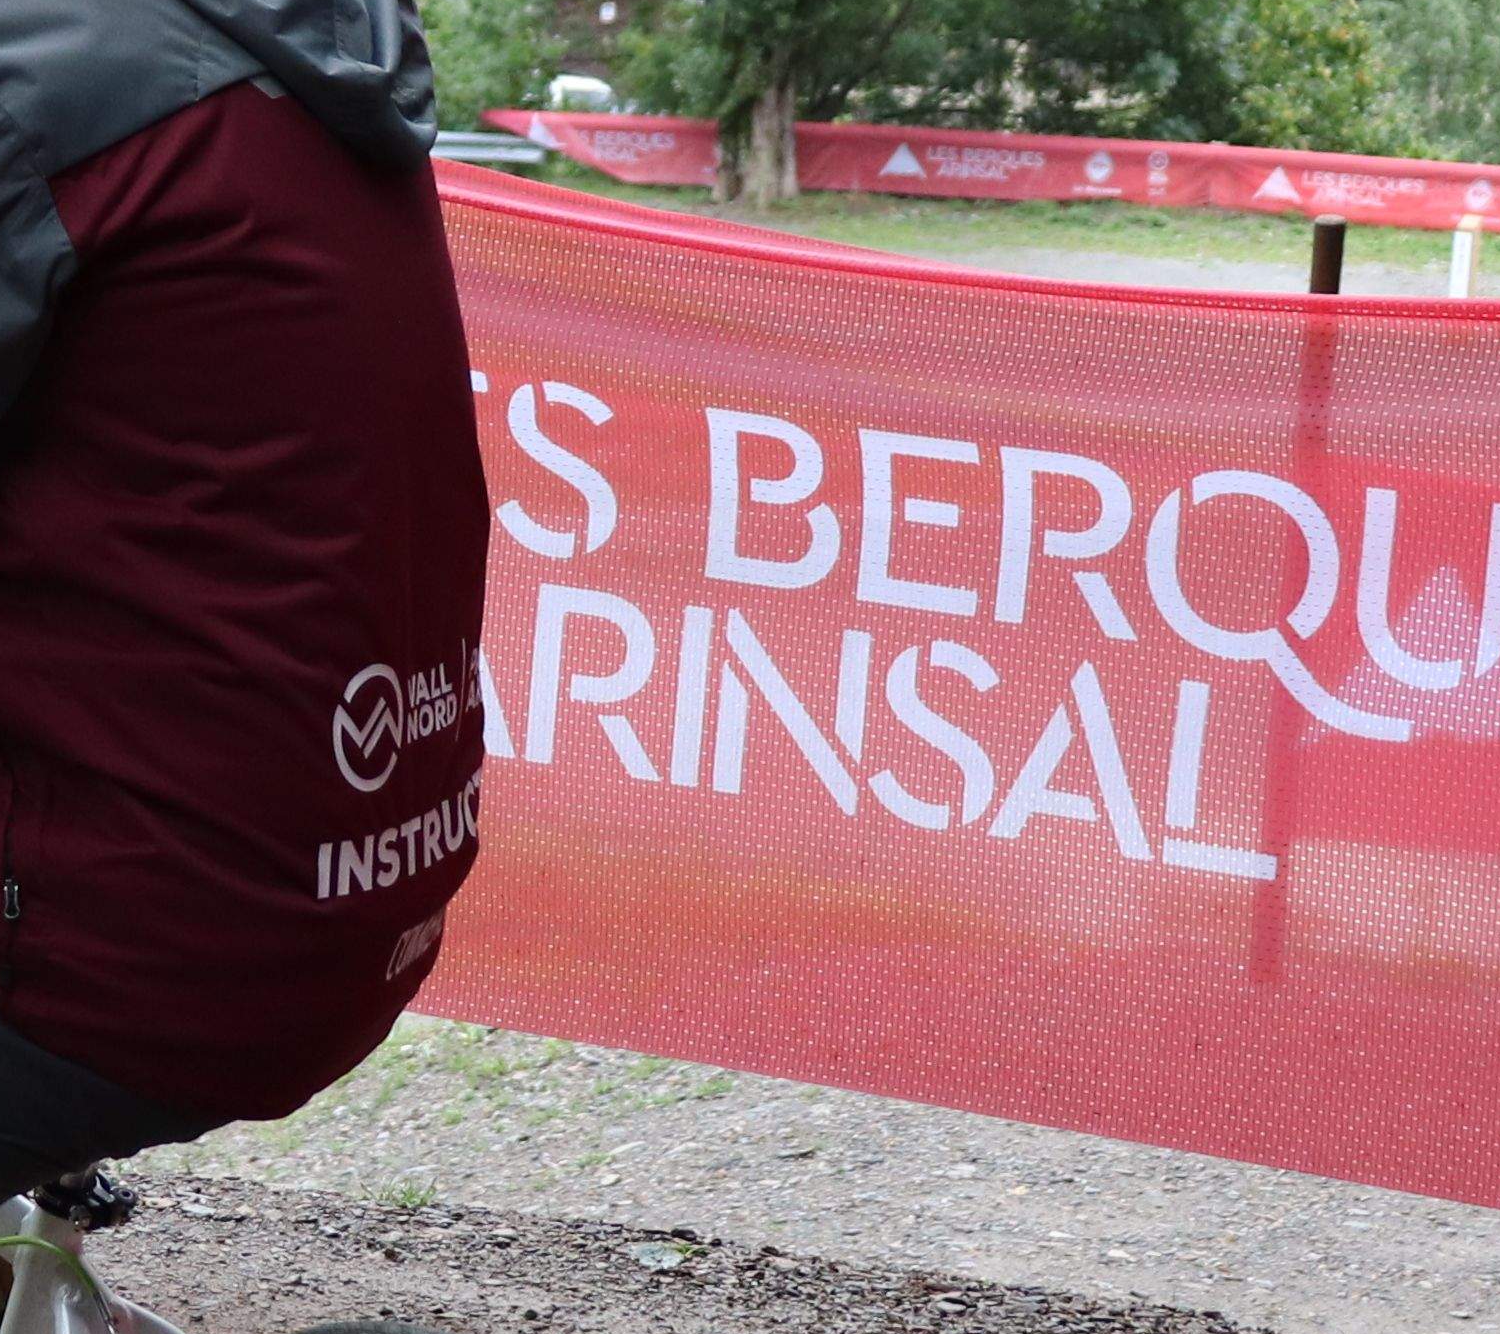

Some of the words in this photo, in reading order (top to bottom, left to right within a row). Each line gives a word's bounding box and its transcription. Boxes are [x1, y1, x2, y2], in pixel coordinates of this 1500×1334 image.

[926, 145, 956, 161] LES
[961, 147, 1045, 168] BERQUES
[1337, 173, 1427, 194] BERQUES
[408, 662, 454, 708] VALL
[407, 692, 458, 745] NORD
[317, 767, 481, 900] INSTRUC
